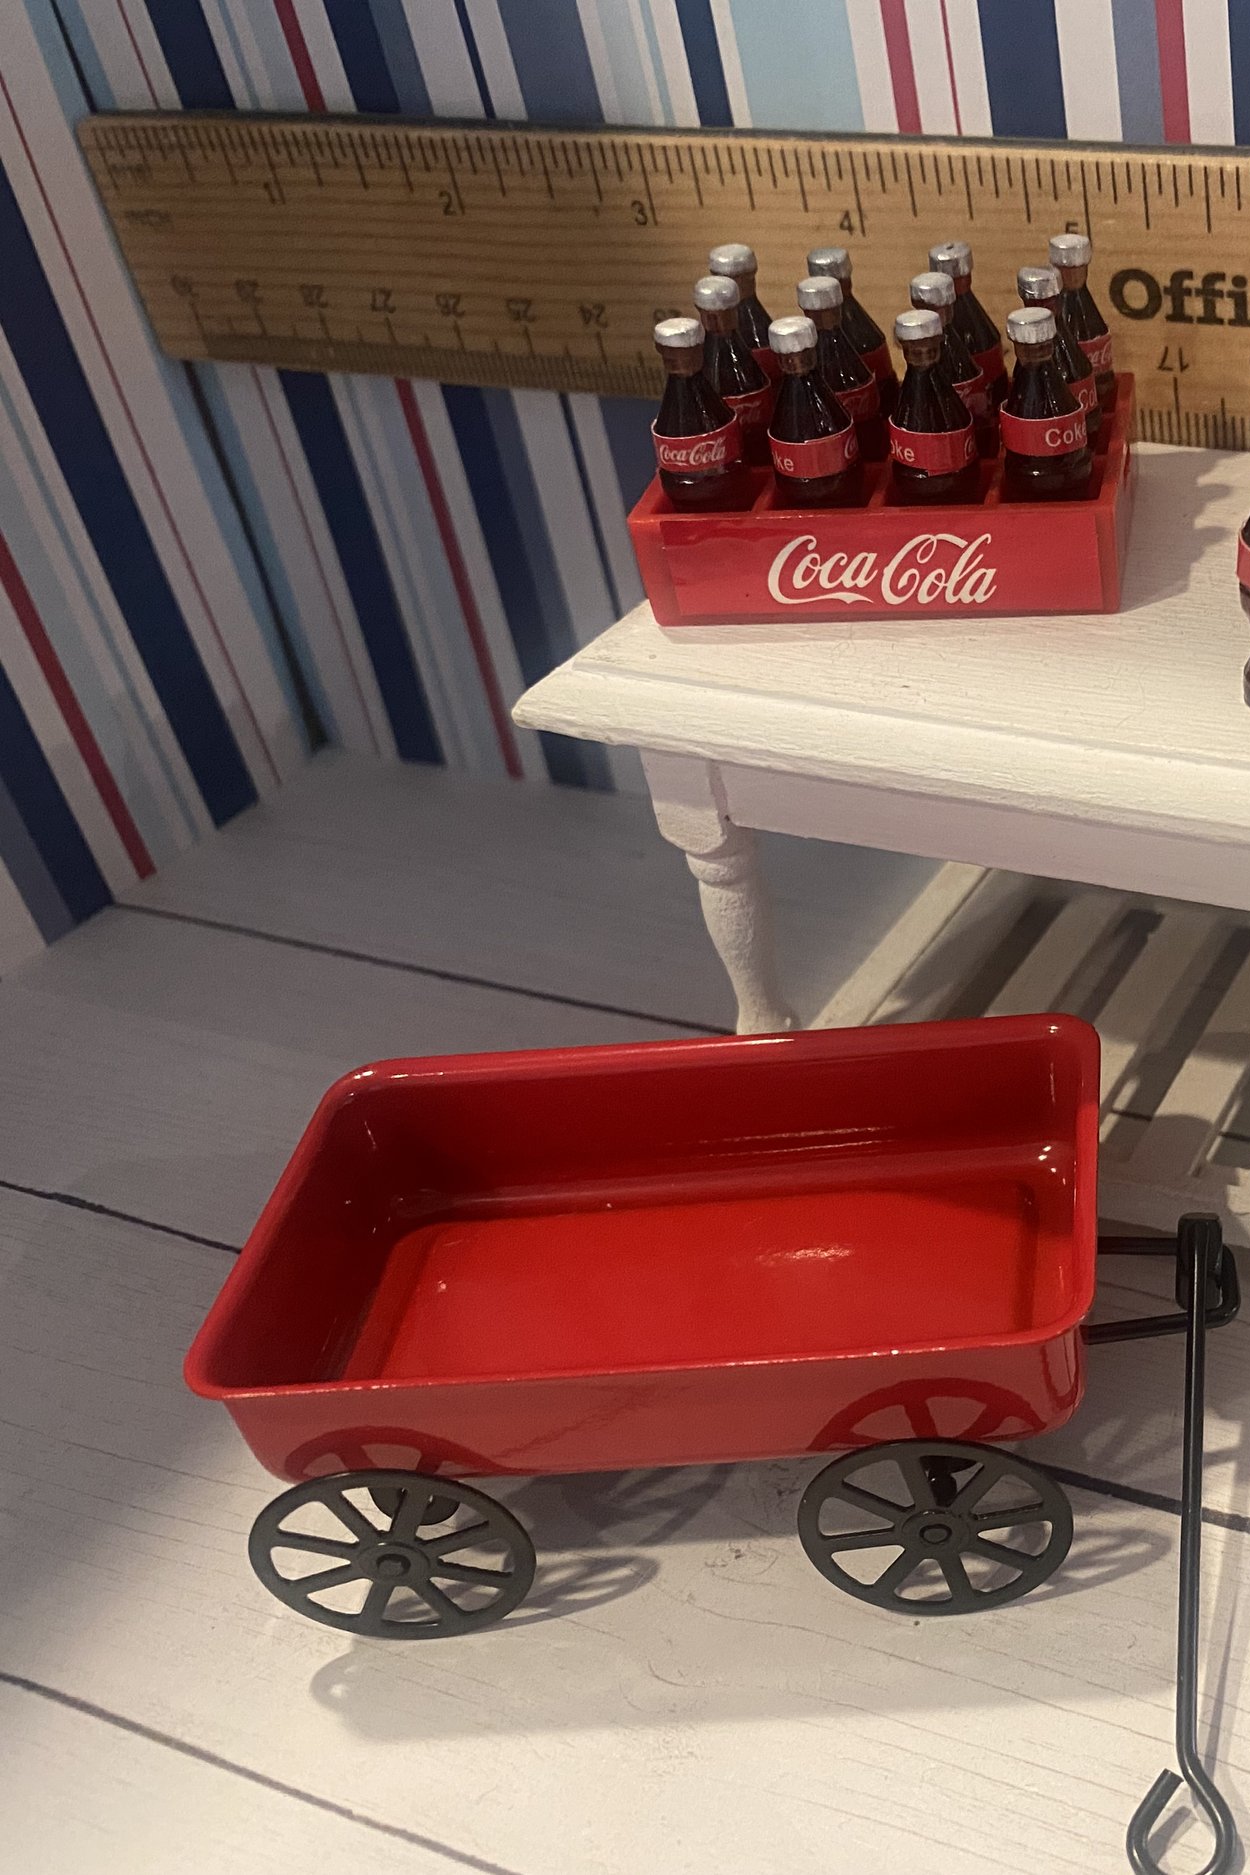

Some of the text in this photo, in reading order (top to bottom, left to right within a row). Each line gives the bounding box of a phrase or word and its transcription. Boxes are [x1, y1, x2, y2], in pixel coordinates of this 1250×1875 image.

[438, 190, 458, 216] 2
[631, 200, 649, 226] 3
[839, 209, 855, 236] 4
[371, 286, 397, 314] 27
[435, 293, 466, 318] 26
[506, 299, 537, 324] 25
[579, 301, 609, 329] 24
[1156, 346, 1190, 374] 17
[768, 533, 998, 605] Coca Cola
